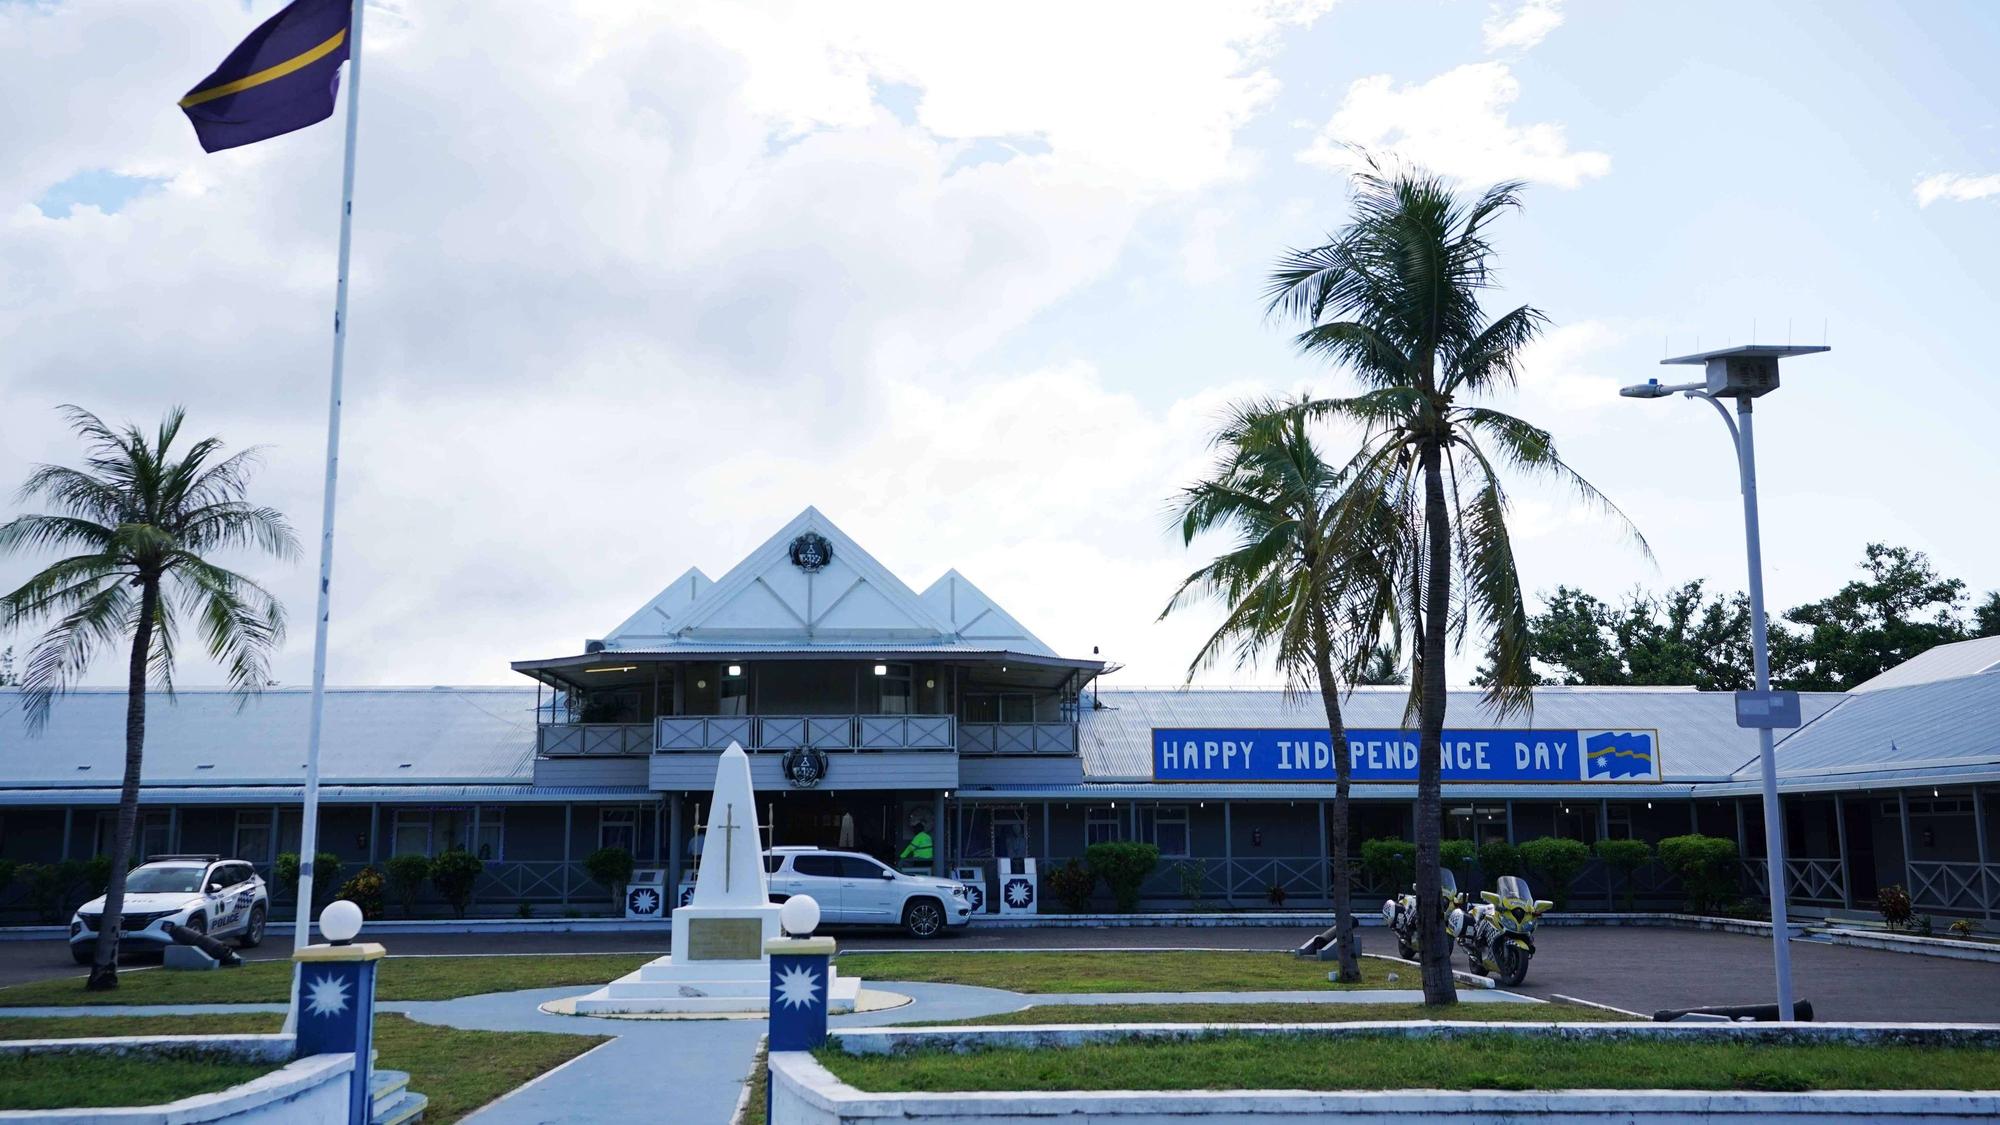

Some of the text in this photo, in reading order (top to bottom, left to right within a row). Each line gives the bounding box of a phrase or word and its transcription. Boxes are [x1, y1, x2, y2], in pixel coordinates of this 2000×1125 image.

[1163, 741, 1567, 770] HAPPY INDPENDNCE DAY
[211, 912, 240, 930] POLICE
